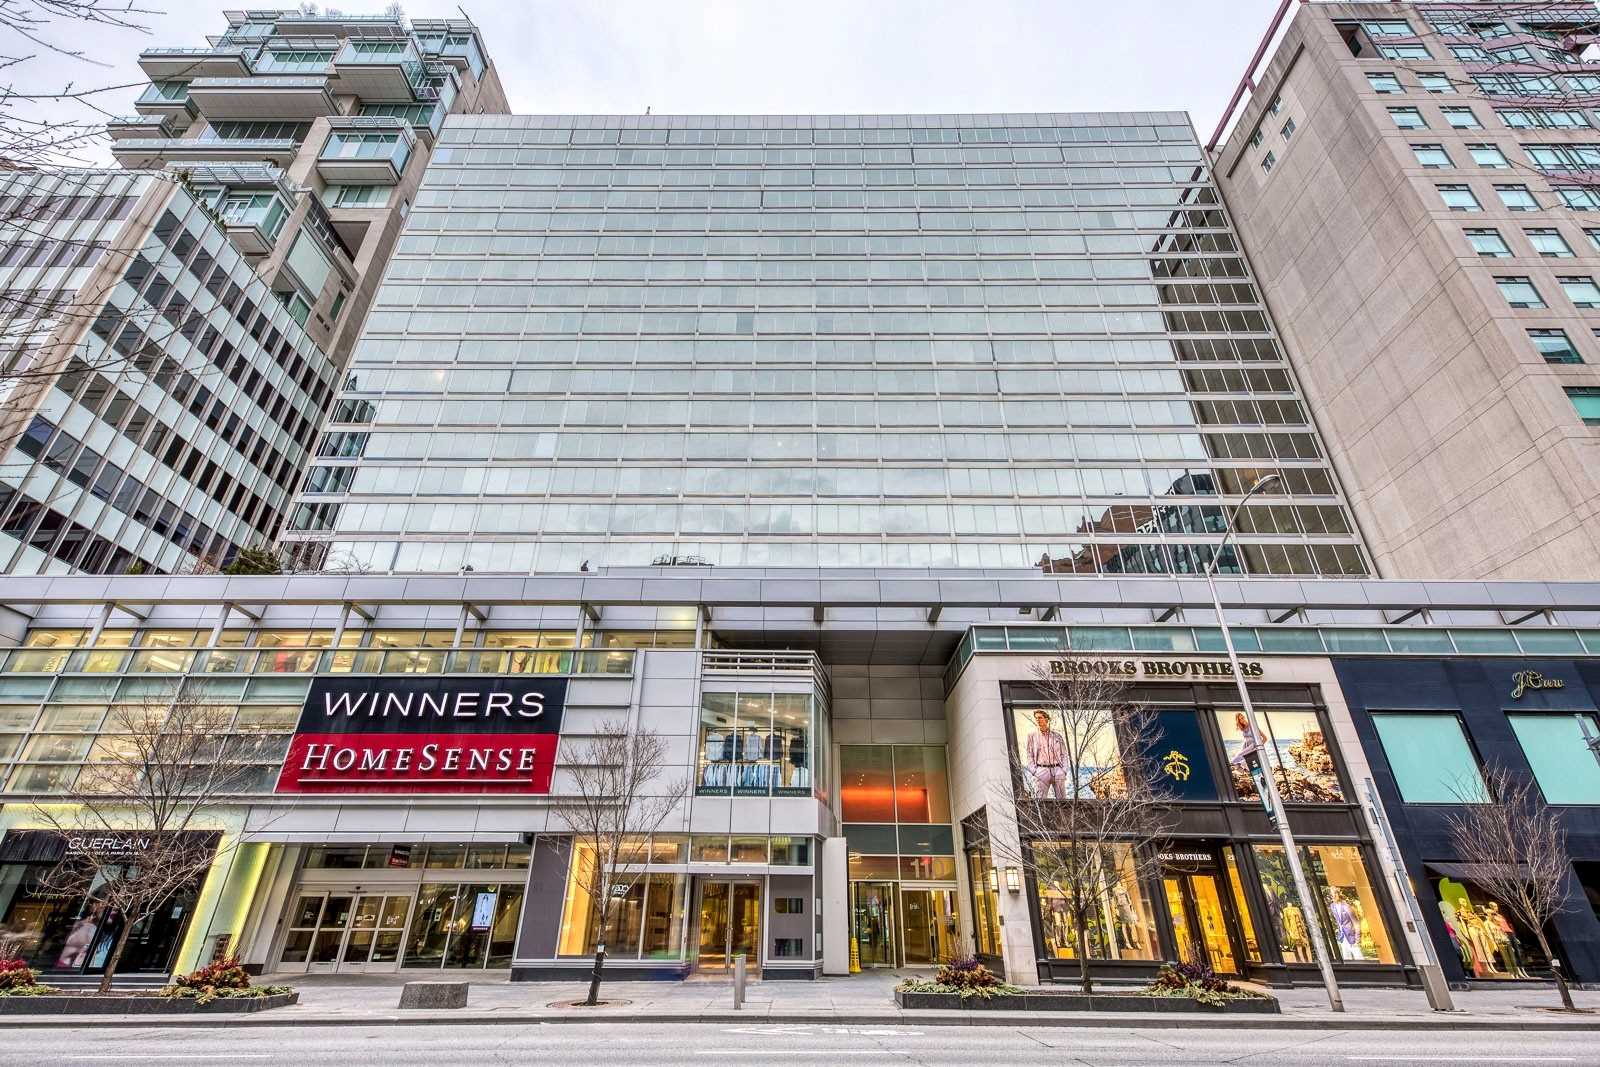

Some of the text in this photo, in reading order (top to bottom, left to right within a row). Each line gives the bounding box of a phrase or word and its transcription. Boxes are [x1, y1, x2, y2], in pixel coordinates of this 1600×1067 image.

[1049, 660, 1264, 677] BROOKS BROTHERS
[325, 692, 545, 716] WINNERS
[69, 837, 150, 849] GUERLAIN
[1175, 853, 1212, 861] BROTHERS
